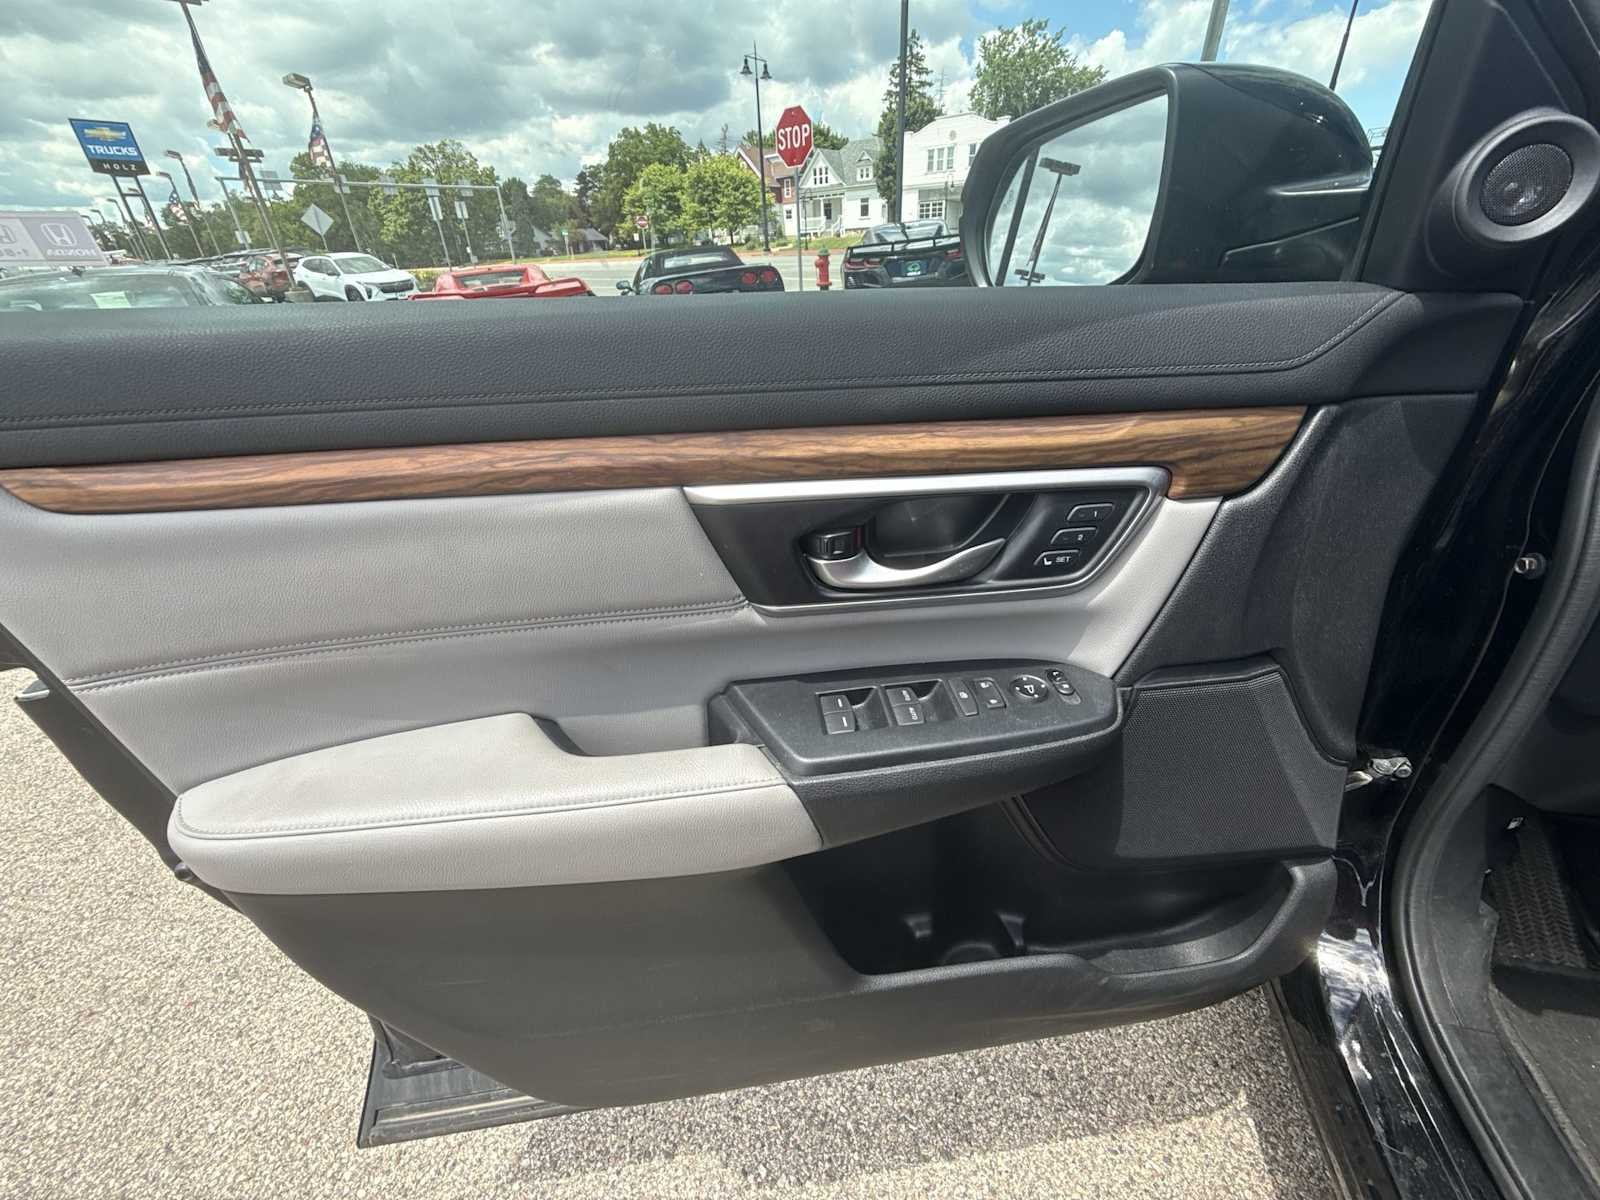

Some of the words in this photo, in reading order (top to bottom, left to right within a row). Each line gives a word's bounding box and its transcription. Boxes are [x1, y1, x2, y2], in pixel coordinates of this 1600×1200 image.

[778, 124, 810, 151] STOP
[87, 145, 138, 156] TRUCKS
[103, 163, 137, 171] HOLZ
